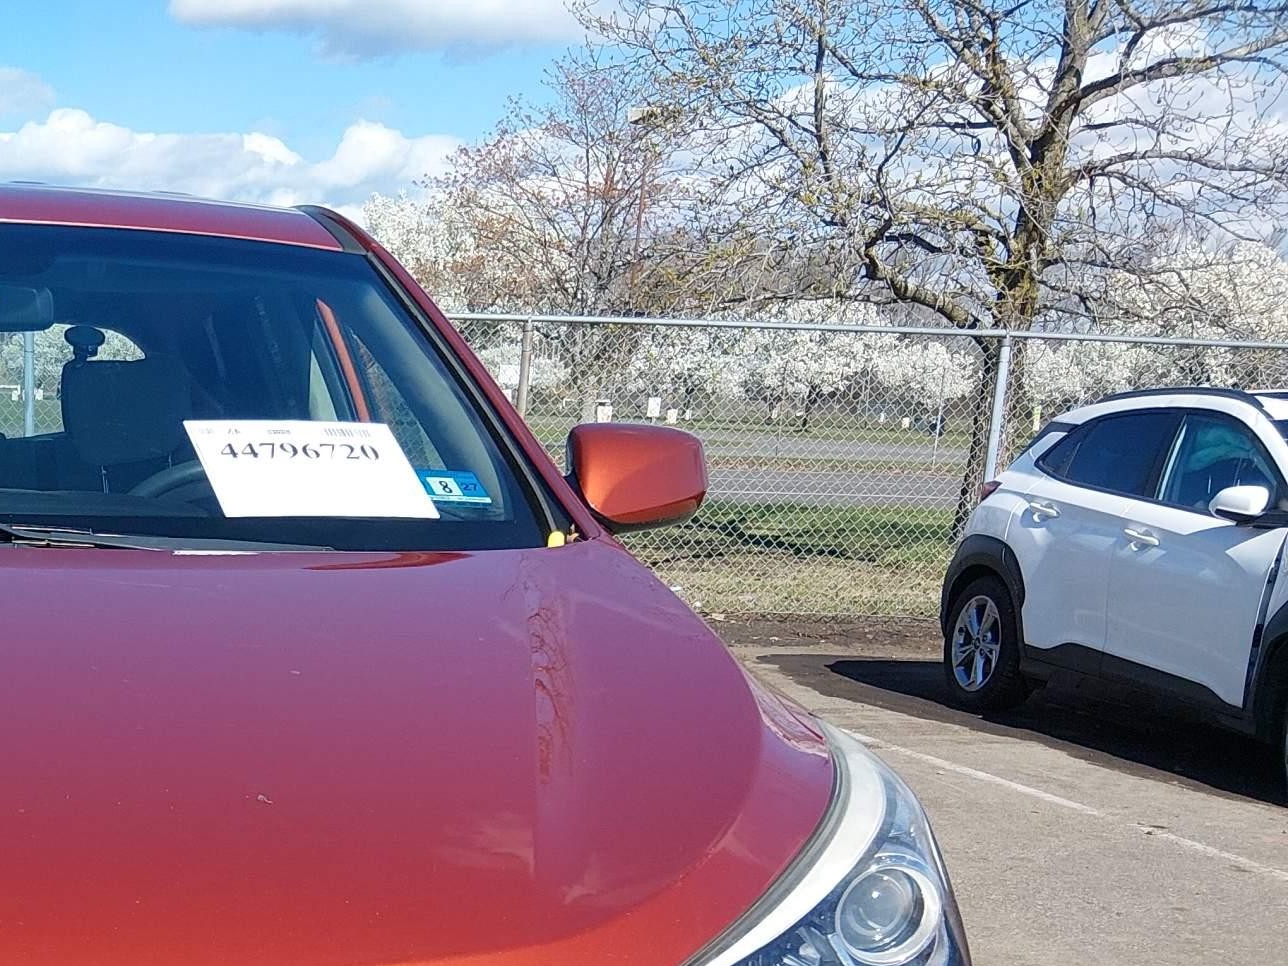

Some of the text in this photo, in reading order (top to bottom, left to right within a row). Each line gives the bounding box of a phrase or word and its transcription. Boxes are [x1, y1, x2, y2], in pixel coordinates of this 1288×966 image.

[220, 441, 380, 462] 44796720
[438, 480, 477, 494] 8 27
